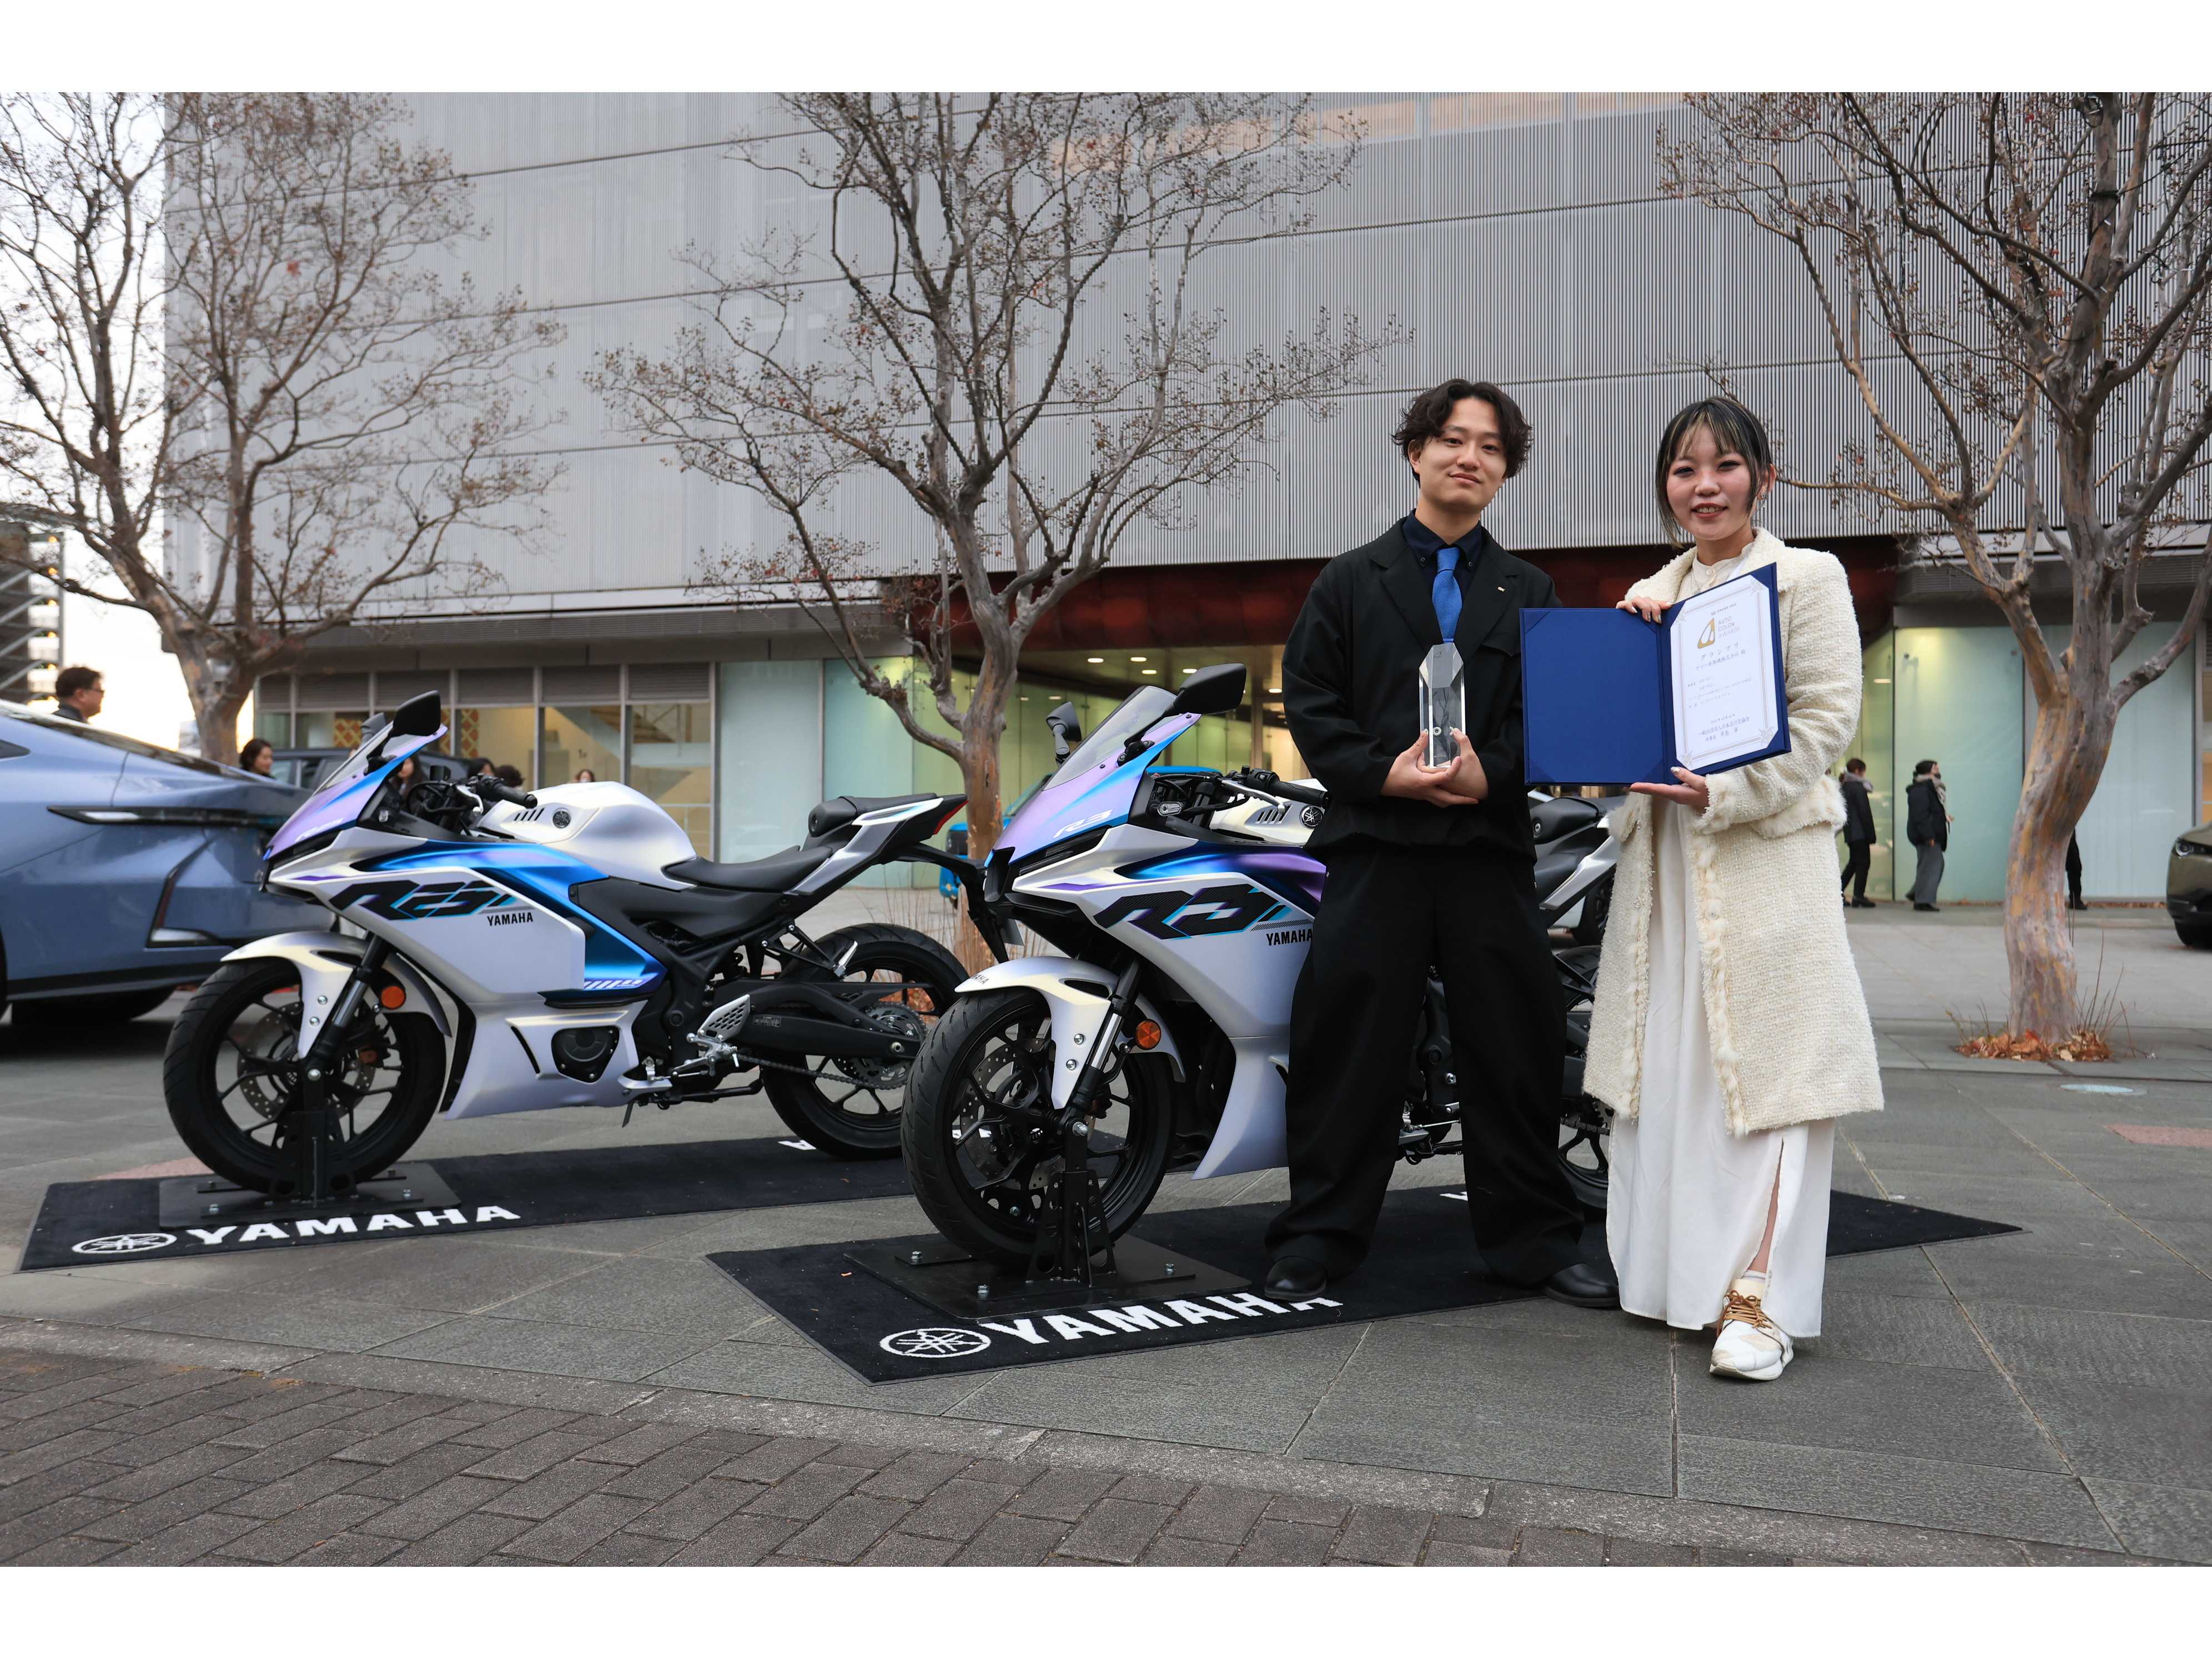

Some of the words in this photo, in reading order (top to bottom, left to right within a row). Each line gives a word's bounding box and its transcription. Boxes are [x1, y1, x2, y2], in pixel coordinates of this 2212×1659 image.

[1718, 616, 1732, 625] AUTO
[1718, 621, 1736, 632] COLOR
[1053, 809, 1113, 838] R3
[487, 912, 533, 926] YAMAHA
[1093, 883, 1280, 939] R3
[1266, 928, 1313, 946] YAMAHA
[186, 1205, 520, 1245] YAMAHA
